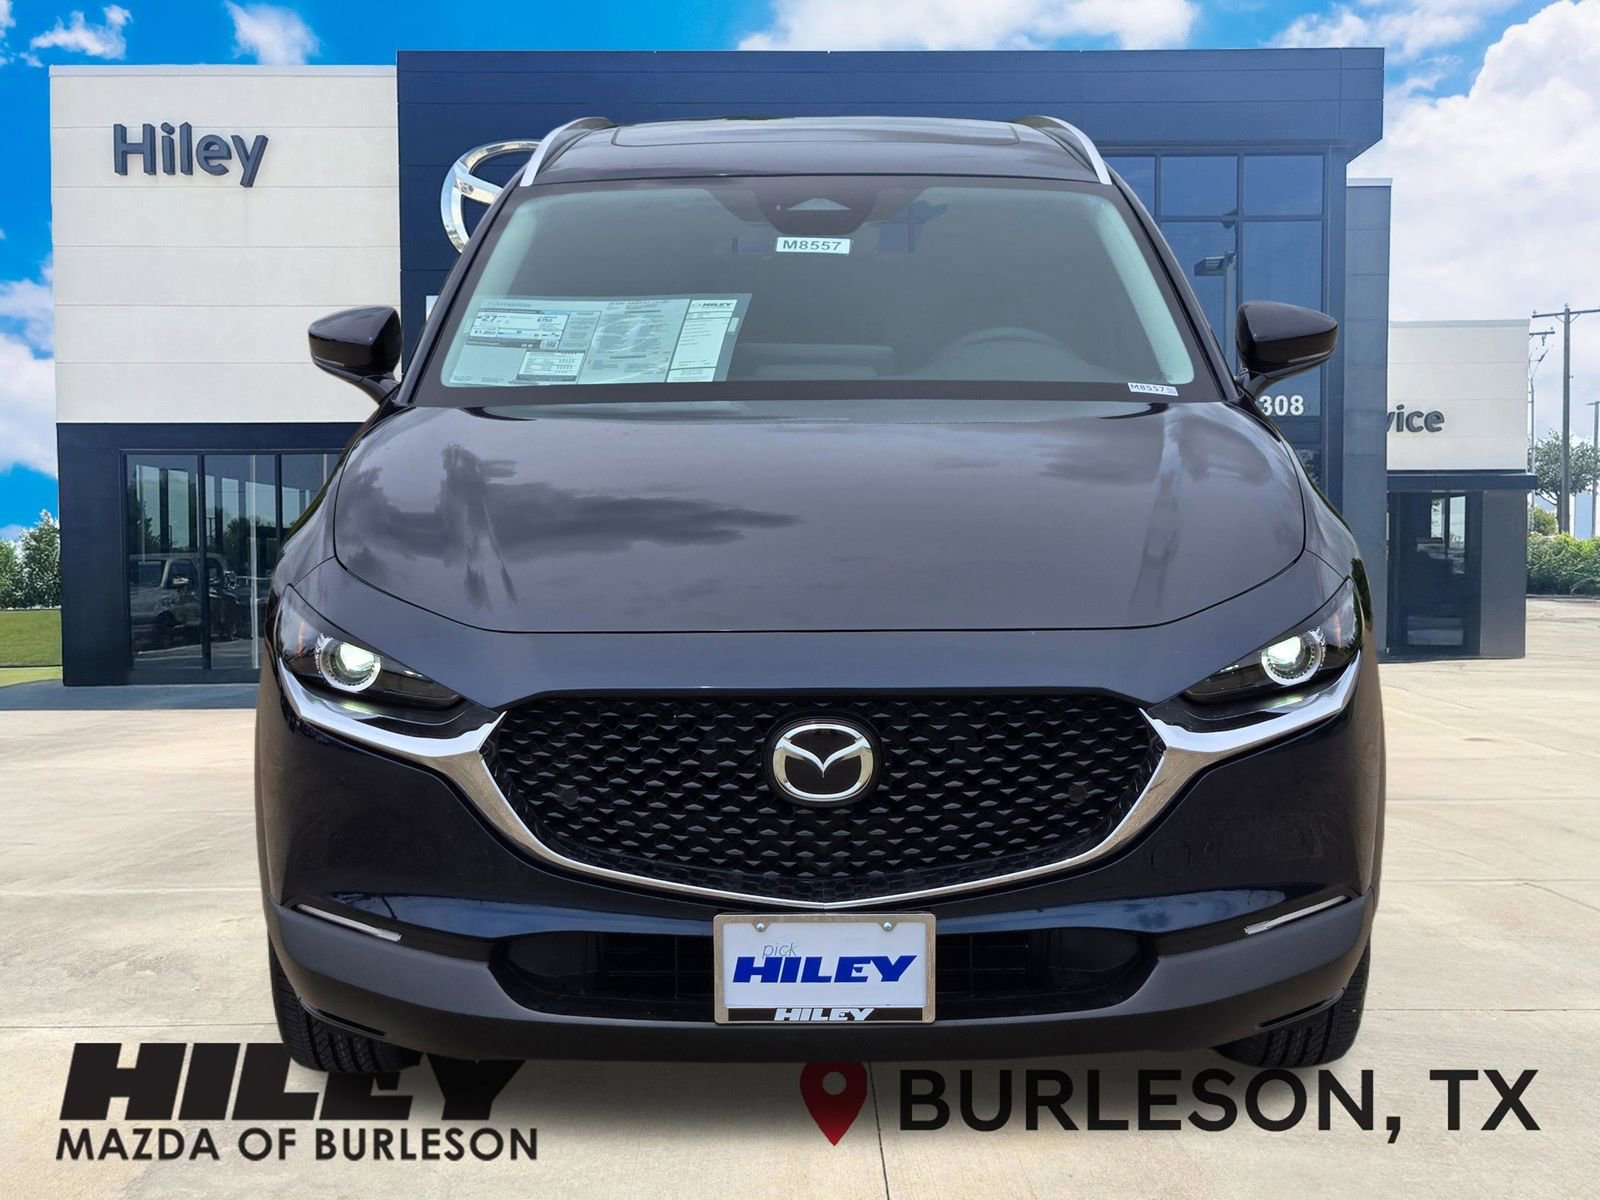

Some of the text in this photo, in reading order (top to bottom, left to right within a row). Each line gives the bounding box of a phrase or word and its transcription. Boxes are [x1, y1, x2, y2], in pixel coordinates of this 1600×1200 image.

[113, 121, 269, 188] Hiley
[782, 239, 842, 251] M8557
[1130, 384, 1165, 393] M8557
[1258, 395, 1304, 416] 308
[762, 942, 799, 959] pick
[732, 955, 917, 983] HILEY
[774, 1008, 874, 1021] HILEY
